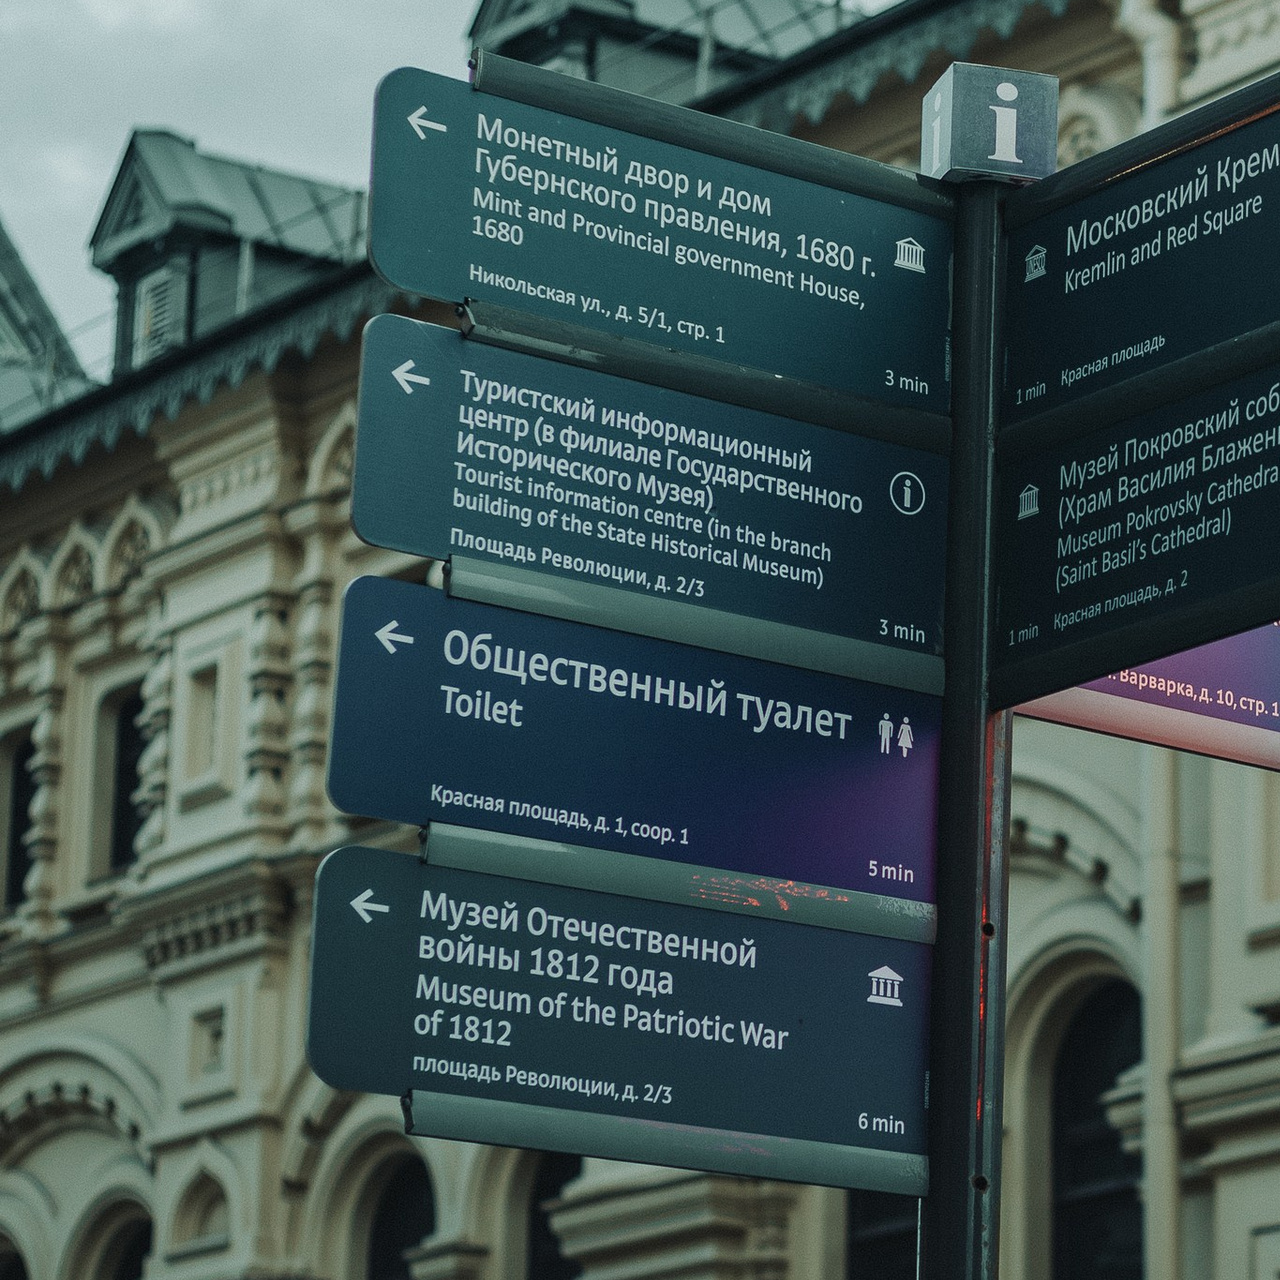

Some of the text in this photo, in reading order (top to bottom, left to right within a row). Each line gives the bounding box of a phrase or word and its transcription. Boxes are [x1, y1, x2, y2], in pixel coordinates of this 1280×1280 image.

[477, 113, 772, 217] Монетный двор и дом
[472, 215, 524, 246] 1680
[475, 147, 876, 278] Губернского правления, 1680 г.
[1065, 194, 1263, 294] Kremlin and Red Square
[1066, 164, 1208, 257] Московский
[473, 186, 865, 311] Mint and Provincial government House,
[469, 263, 725, 344] Никольская ул., д. 5/1, стр. 1
[884, 369, 929, 395] 3 min
[1016, 381, 1046, 405] 1 min
[1060, 334, 1166, 387] Красная площадь
[460, 369, 812, 473] Туристский информационный
[1059, 443, 1119, 490] Музей
[1124, 398, 1240, 466] Покровский
[457, 430, 714, 515] Исторического Музея)
[459, 404, 863, 514] центр (в филиале Государственного
[1058, 487, 1112, 530] (Храм
[1117, 456, 1196, 503] Василия
[453, 461, 832, 562] Tourist information centre (in the branch
[453, 487, 825, 590] building of the State Historical Museum)
[1057, 521, 1122, 559] Museum
[1126, 490, 1204, 534] Pokrovsky
[450, 527, 705, 598] Площадь Революции, д. 2/3
[1055, 557, 1098, 594] (Saint
[1150, 506, 1232, 556] Cathedral)
[879, 618, 926, 644] 3 min
[1008, 624, 1039, 646] 1 min
[1053, 569, 1188, 631] Красная площадь, д. 2
[440, 684, 524, 727] Toilet
[443, 629, 853, 740] Общественный туалет
[1119, 669, 1280, 717] Варварка, д. 10, стр. 1
[430, 783, 689, 846] Красная площадь, д. 1, соор. 1
[868, 859, 914, 883] 5 min
[420, 889, 757, 969] Музей Отечественной
[418, 933, 673, 999] войны 1812 года
[413, 1009, 512, 1047] of 1812
[415, 973, 790, 1050] Museum of the Patriotic War
[413, 1055, 673, 1104] площадь Революции, д. 2/3
[858, 1112, 905, 1135] 6 min
